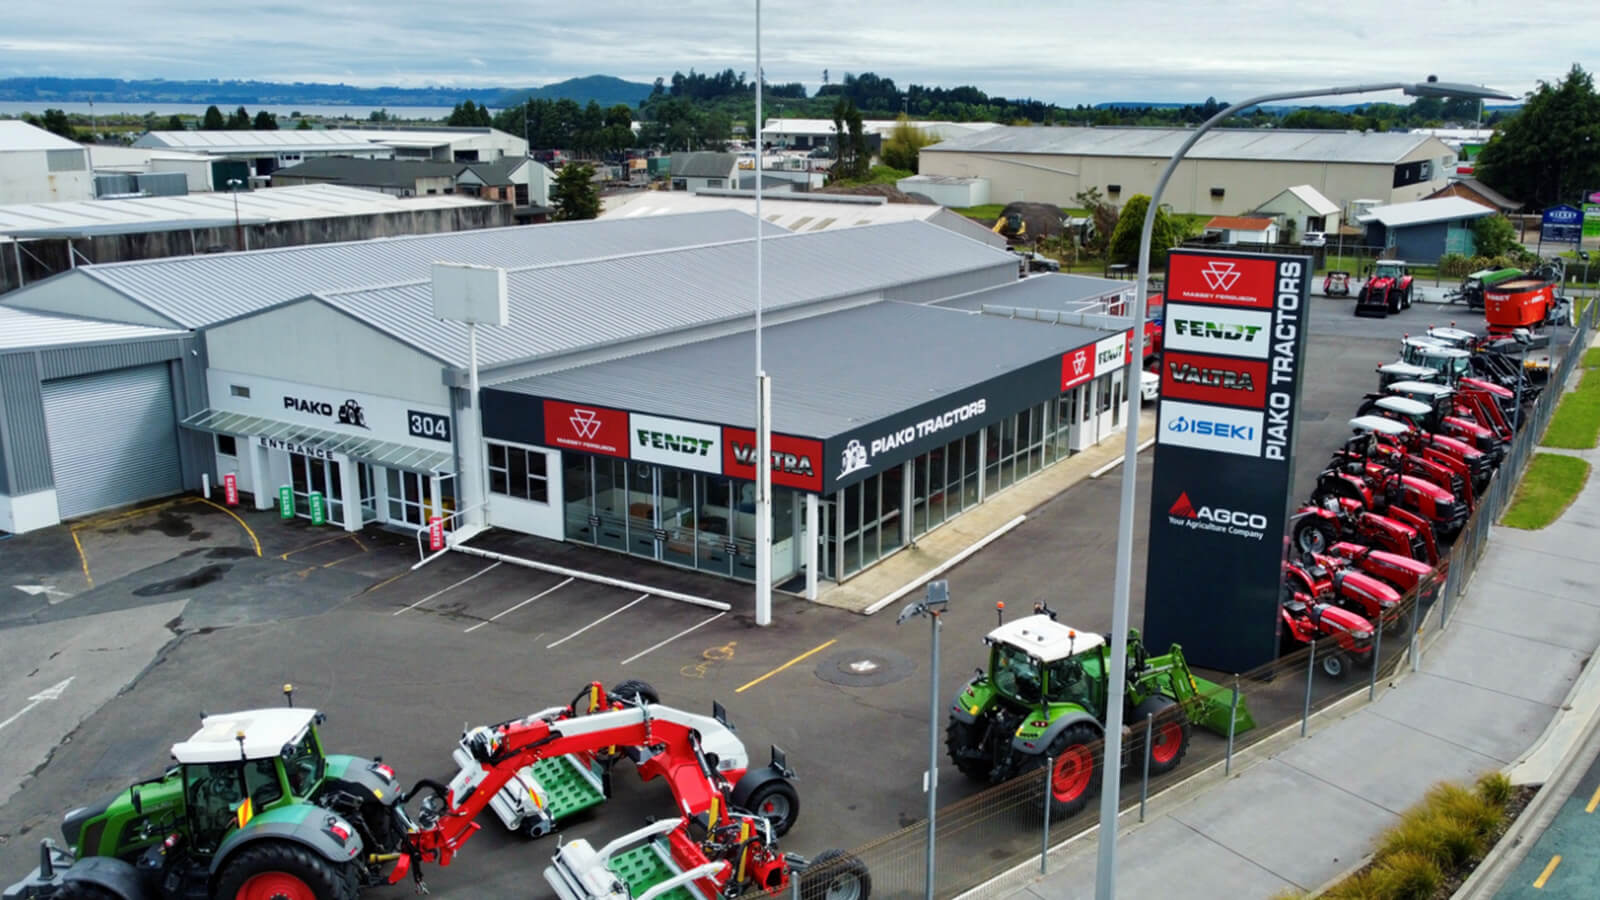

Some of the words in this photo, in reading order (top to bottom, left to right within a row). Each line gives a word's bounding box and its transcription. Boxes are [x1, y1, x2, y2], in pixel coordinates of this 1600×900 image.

[1182, 291, 1214, 299] MASSEY
[1215, 294, 1257, 302] FERGUSON
[1173, 318, 1262, 342] FENDT
[1272, 262, 1301, 385] TRACTORS
[1169, 362, 1255, 391] VALTRA
[283, 396, 333, 416] PIAKO
[411, 415, 447, 438] 304
[871, 427, 915, 457] PIAKO
[916, 398, 987, 439] TRACTORS
[1191, 419, 1254, 441] ISEKI
[1266, 392, 1290, 460] PIAKO
[260, 437, 334, 460] ENTRANCE
[556, 437, 582, 447] MASSEY
[583, 441, 617, 452] FERGUSON
[637, 428, 714, 456] FENDT
[731, 440, 814, 477] VATRA
[1168, 516, 1185, 526] Your
[1186, 519, 1226, 533] Agriculture
[1228, 526, 1264, 540] Company
[1197, 506, 1267, 529] AGCO
